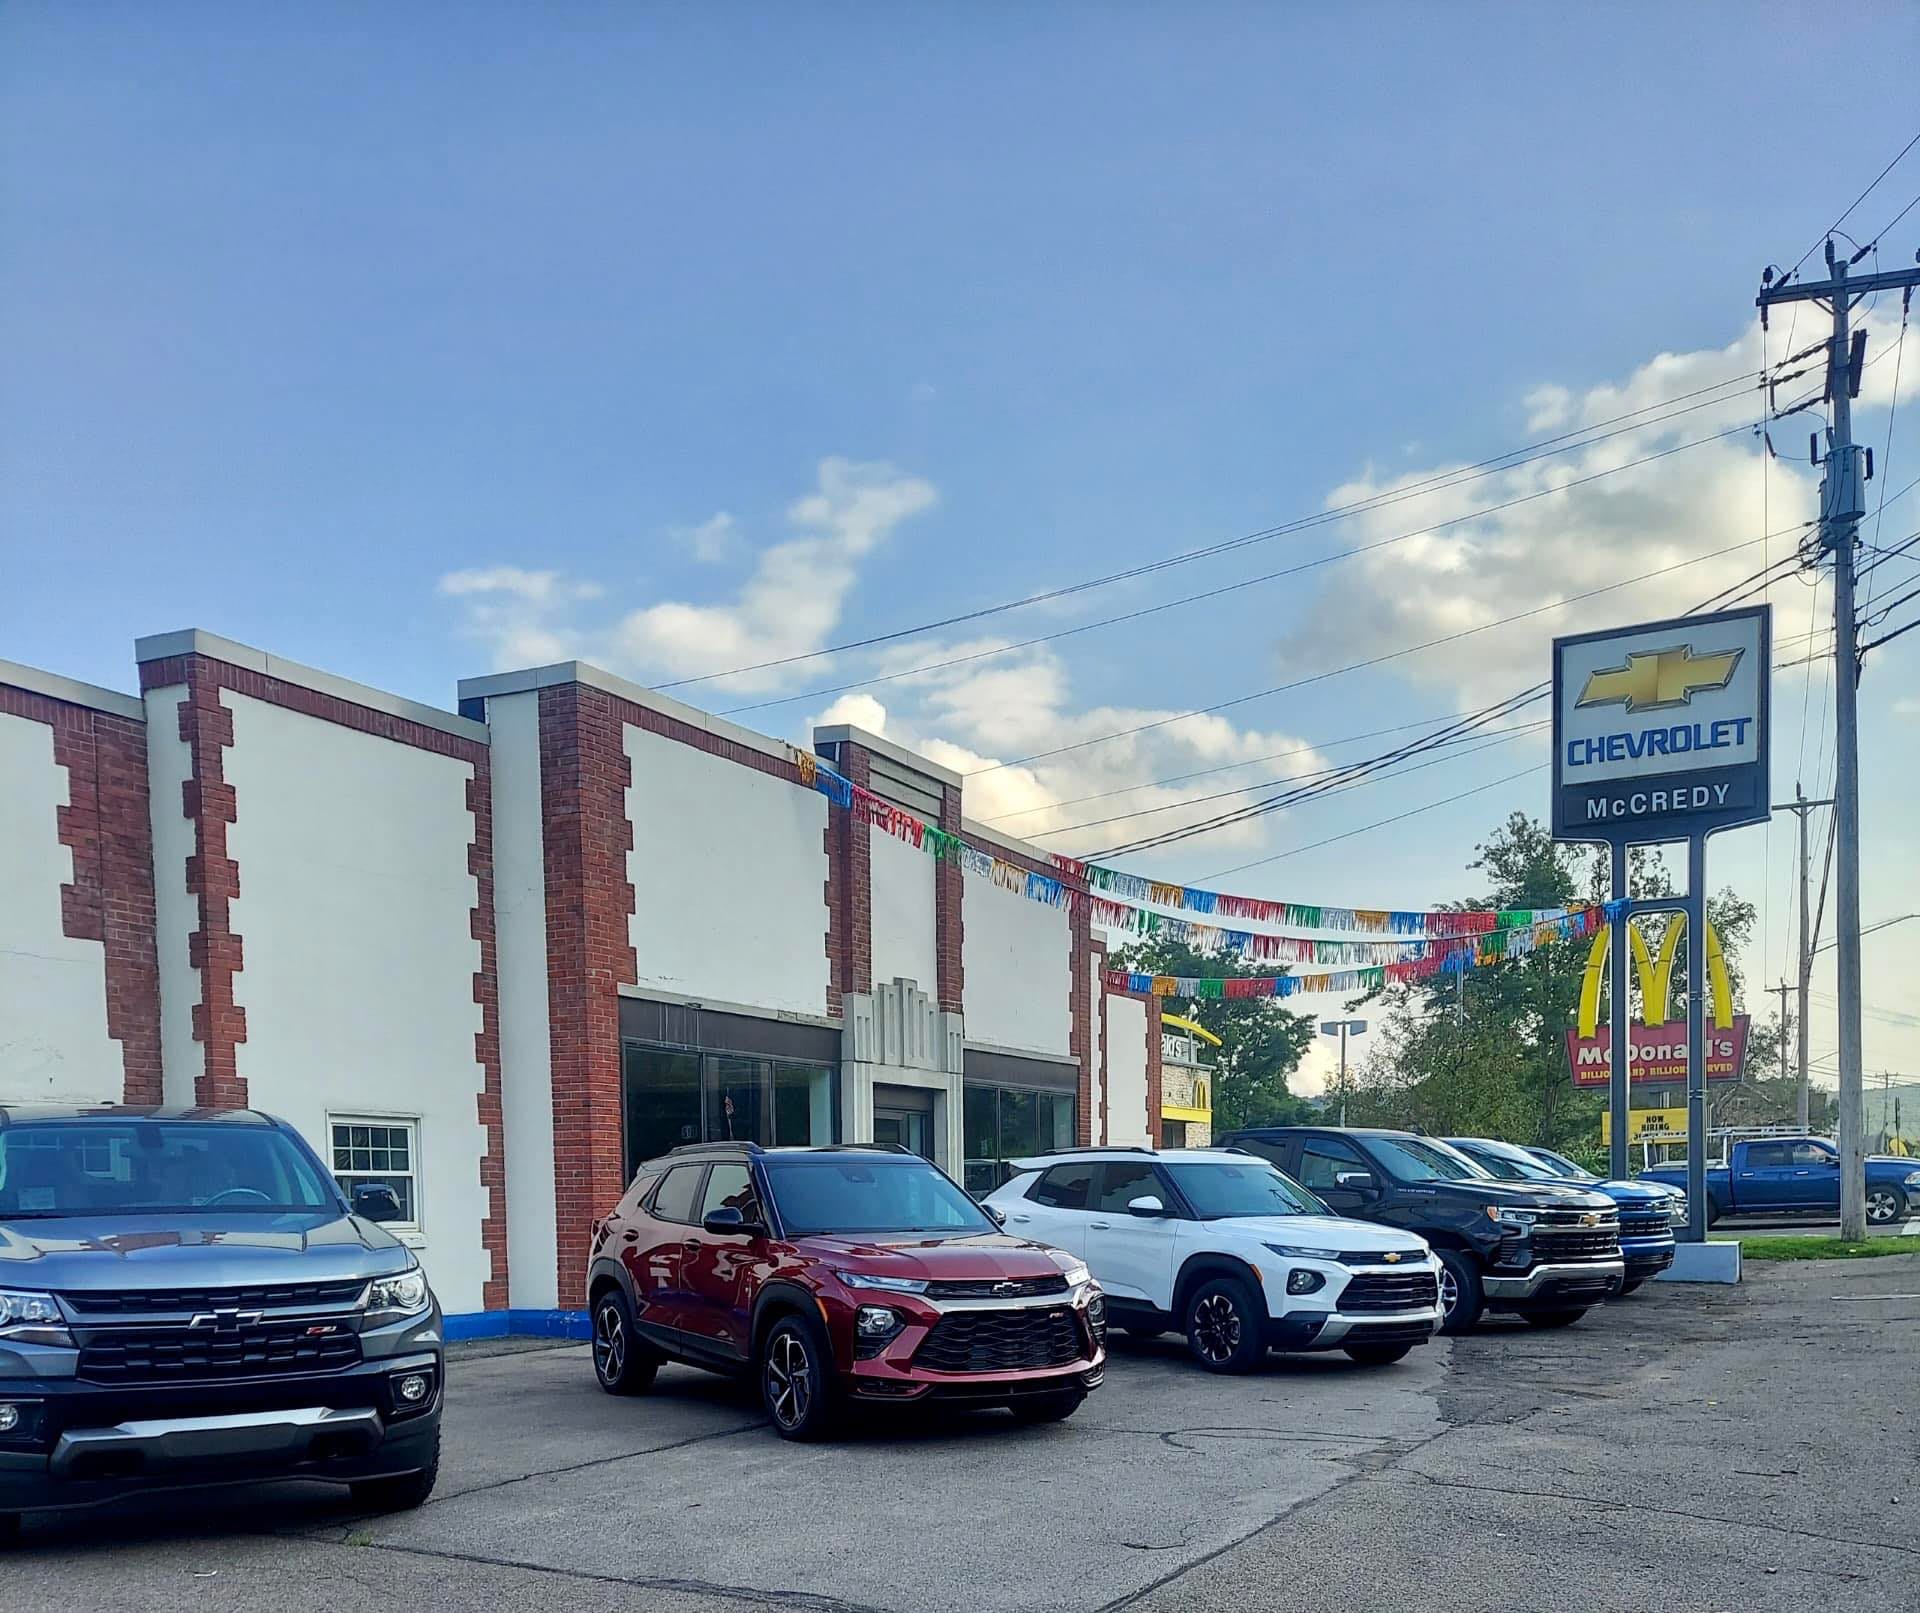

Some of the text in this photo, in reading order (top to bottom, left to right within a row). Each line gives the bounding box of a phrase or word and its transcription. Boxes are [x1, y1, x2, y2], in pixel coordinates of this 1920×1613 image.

[1567, 717, 1752, 766] CHEVROLET
[1587, 783, 1730, 819] McCREDY
[1641, 1123, 1670, 1132] HIRING
[1646, 1115, 1664, 1123] NOW
